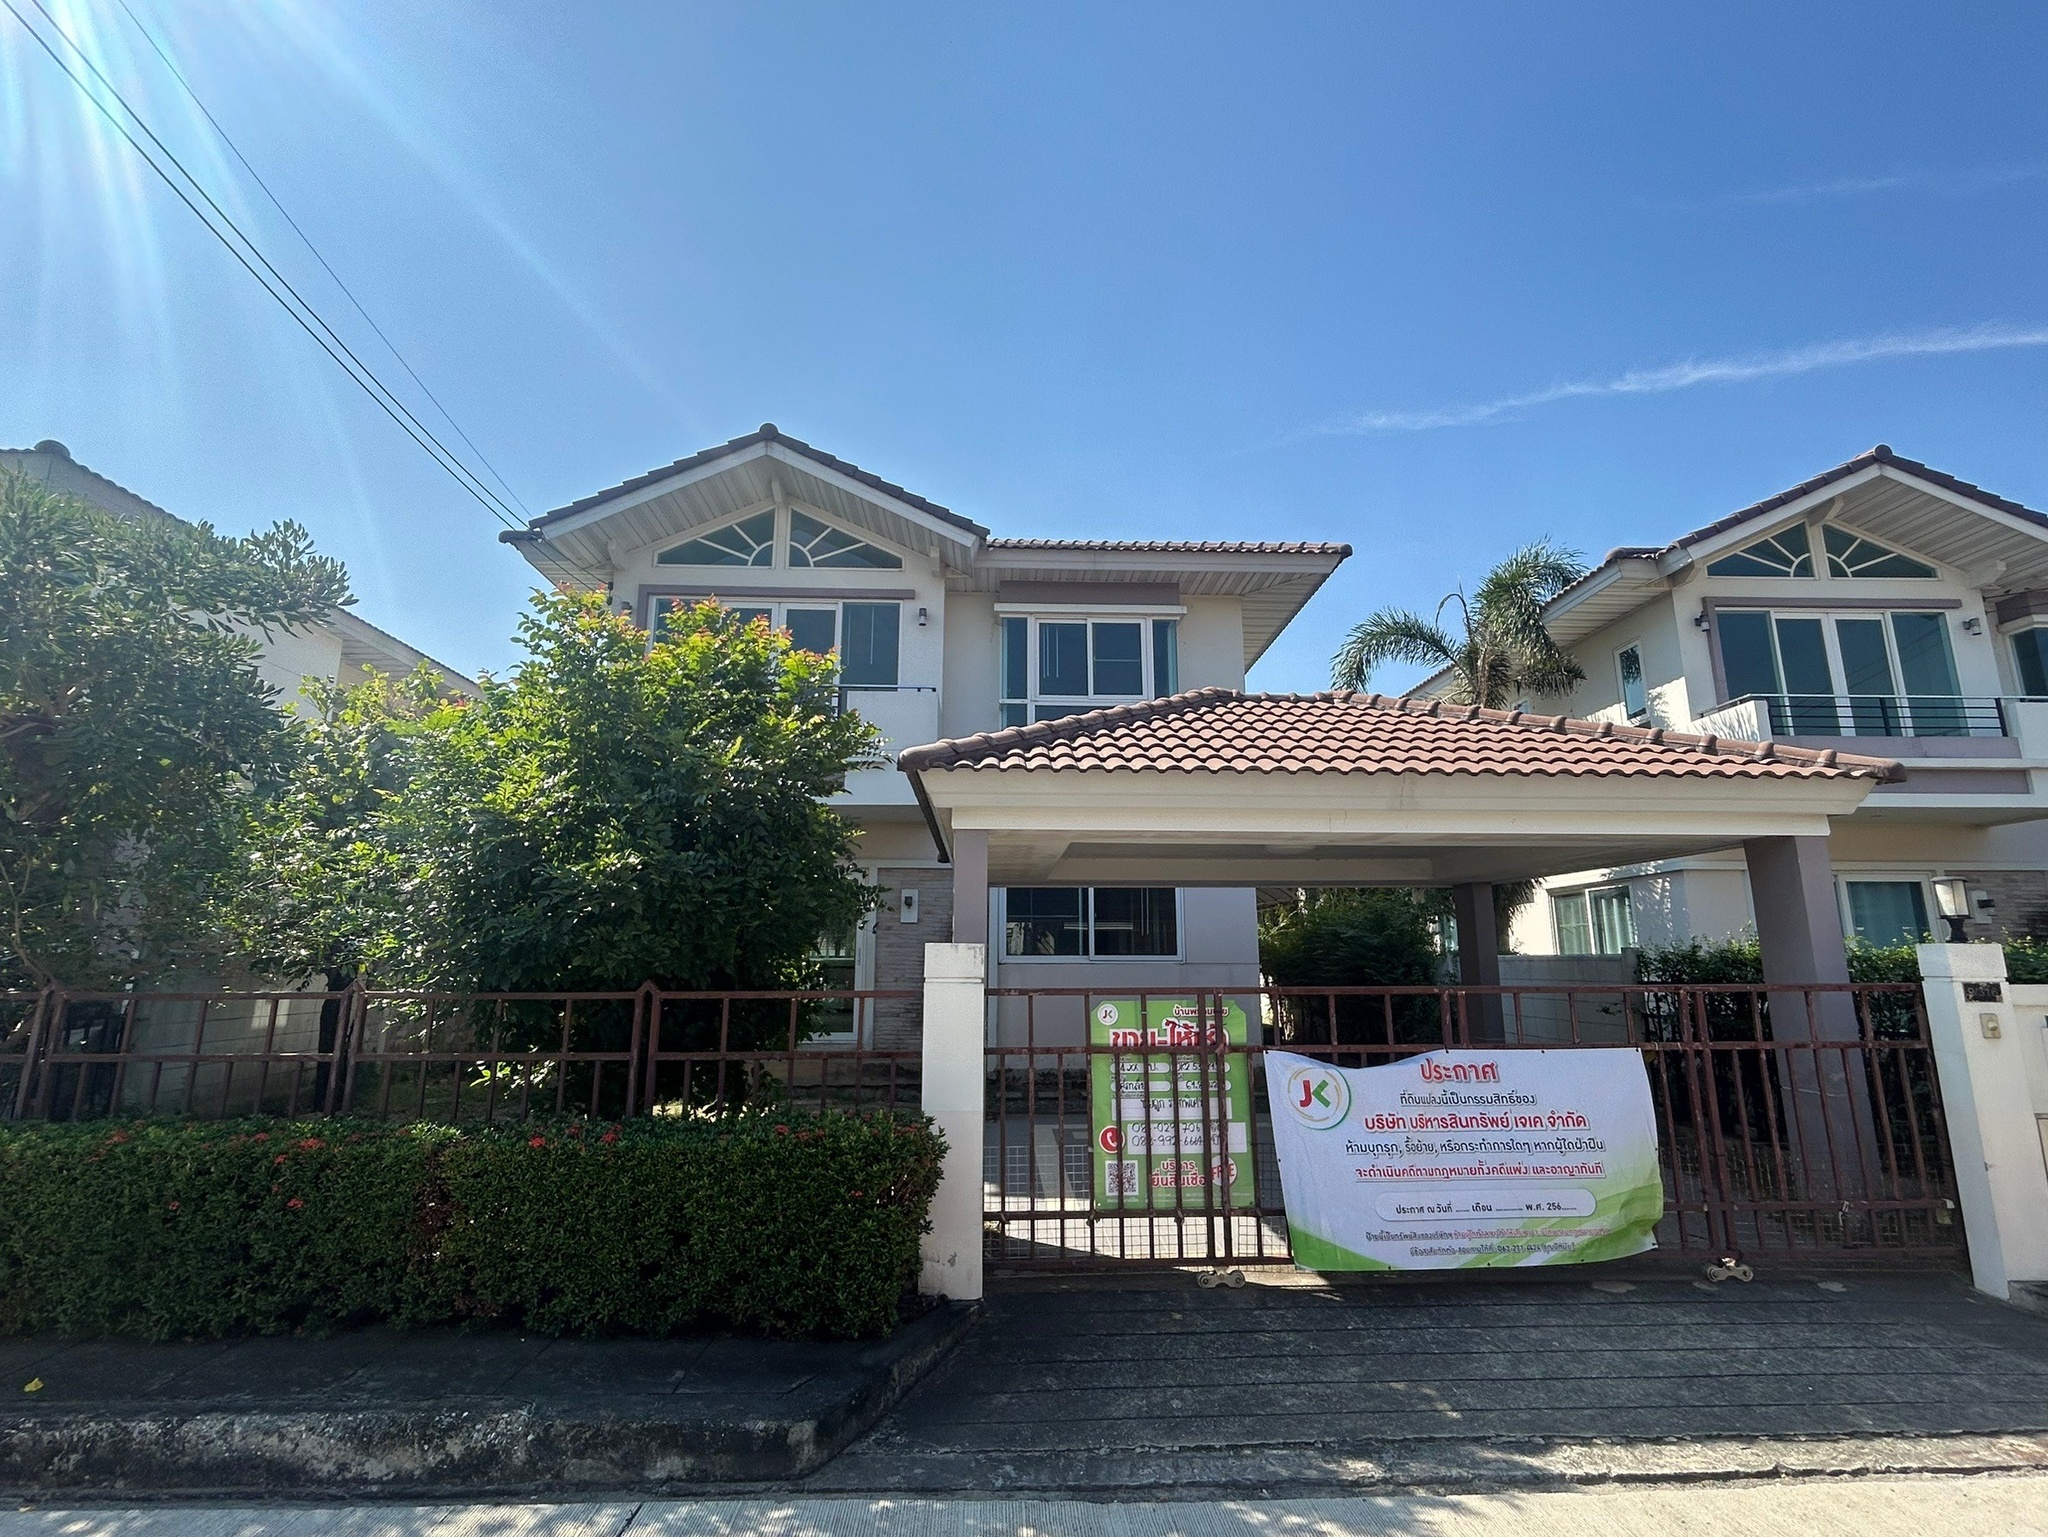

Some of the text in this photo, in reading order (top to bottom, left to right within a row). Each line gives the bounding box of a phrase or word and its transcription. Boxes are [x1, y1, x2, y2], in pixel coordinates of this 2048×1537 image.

[1102, 1009, 1113, 1019] JK
[1420, 1058, 1498, 1081] ประกาศ
[1299, 1079, 1332, 1108] JK
[1400, 1089, 1536, 1105] ที่ดินแปลงนี้เป็นกรรมสิทธิ์ของ
[1365, 1110, 1587, 1130] บริษัท บริหารสินทรัพย์ เจเค จำกัด
[1345, 1140, 1402, 1157] ห้ามบุกรุก,
[1439, 1137, 1530, 1153] หรือกระทำการใดๆ
[1533, 1137, 1604, 1155] หากผู้ใดฝ่าฝืน
[1162, 1159, 1195, 1170] บริาร
[1355, 1159, 1604, 1180] จะดำเนินคดีตามกฎหมายทั้งคดีแพ่ง และอาญาทันที
[1396, 1204, 1425, 1214] ประกาศ
[1436, 1201, 1453, 1213] วันที่
[1471, 1203, 1493, 1212] เดือน
[1525, 1203, 1545, 1211] พ.ศ.
